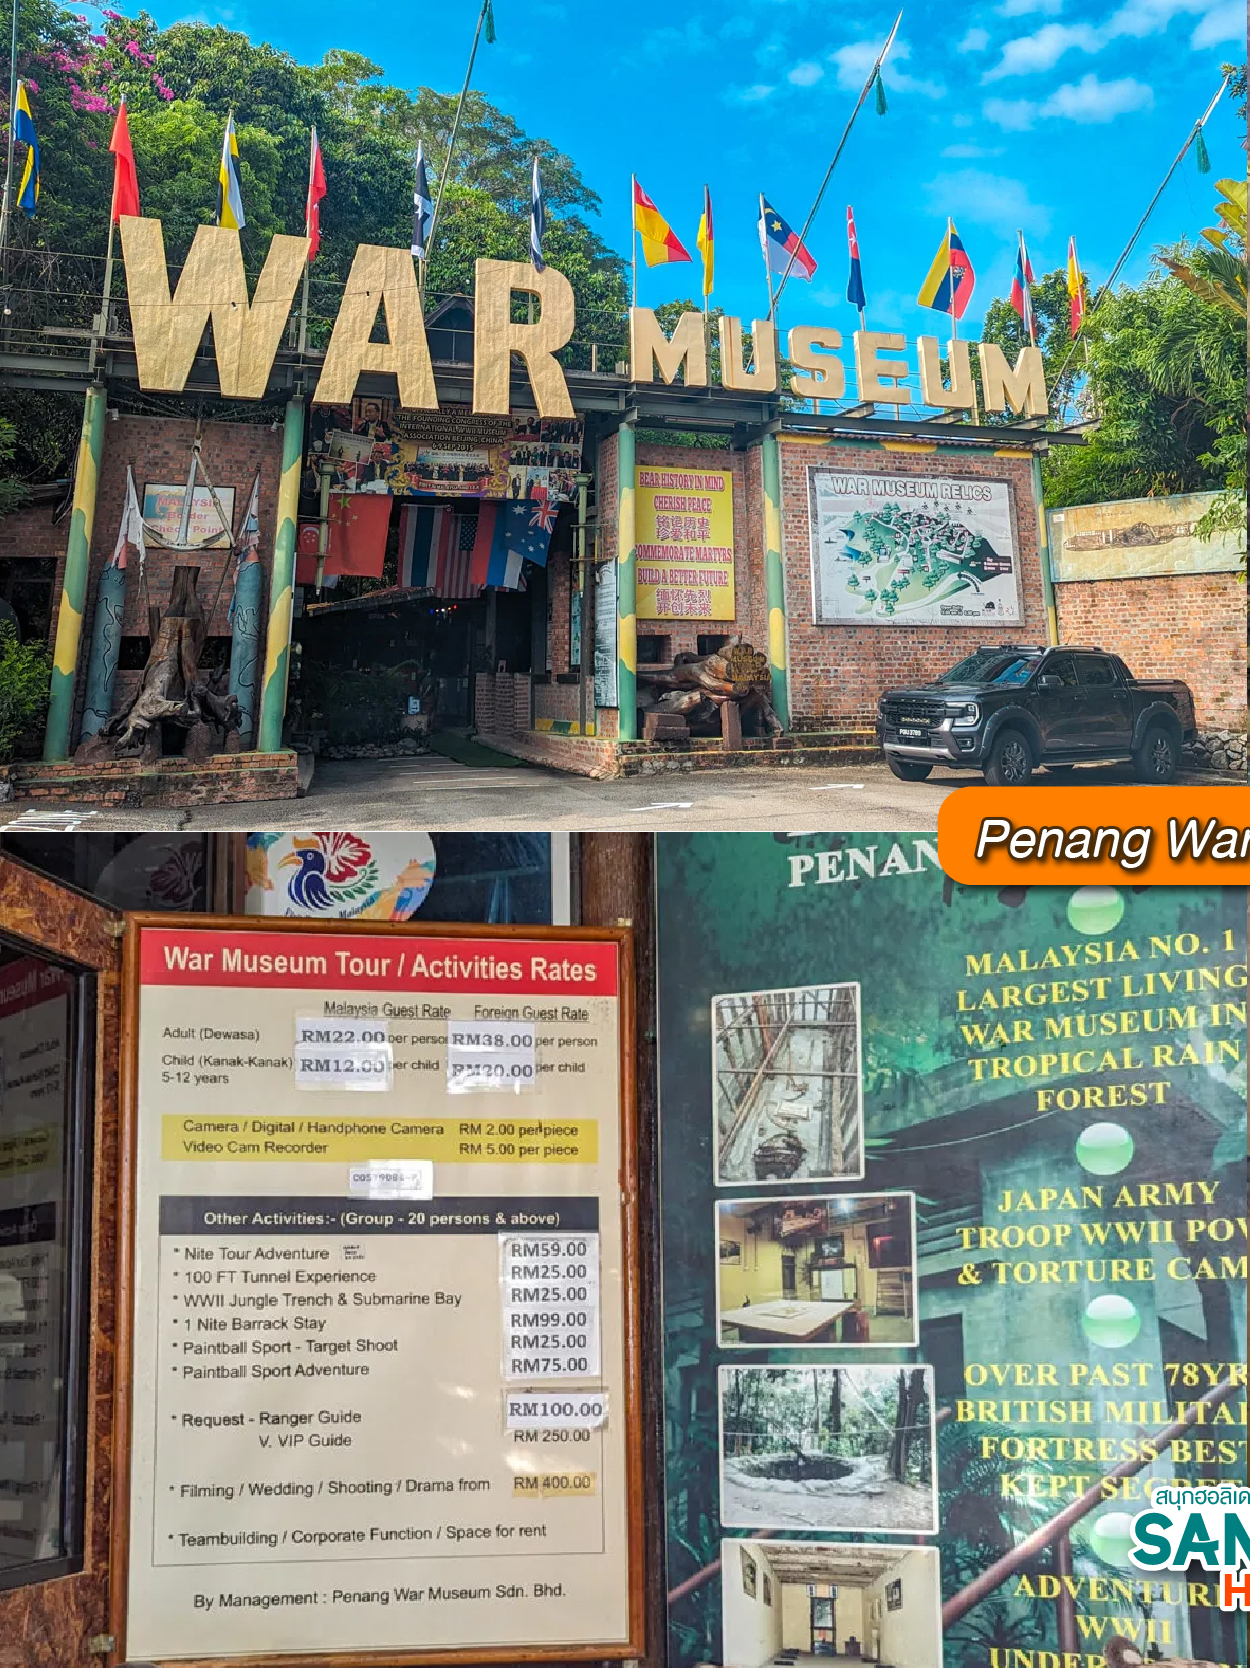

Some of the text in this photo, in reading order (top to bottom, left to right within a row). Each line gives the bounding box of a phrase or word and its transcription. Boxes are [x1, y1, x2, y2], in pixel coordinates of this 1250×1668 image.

[119, 215, 1050, 419] WAR MUSEUM
[399, 424, 456, 433] INTERNATIONAL
[477, 428, 506, 436] MUSEUM
[413, 416, 450, 424] FOUNDING
[404, 433, 450, 441] ASSOCIATION
[639, 472, 724, 491] BEAR HISTORY IN MIND
[832, 477, 992, 501] WAR MUSEUM RELICS
[167, 512, 209, 520] Boder
[654, 495, 712, 513] CHERISH PEACE
[656, 528, 711, 542] 珍爱和平
[695, 546, 732, 563] MARTYRS
[638, 568, 729, 586] BUILD A BETTER FUTURE
[164, 946, 213, 972] War
[221, 948, 327, 976] Museum
[335, 951, 390, 978] Tour
[412, 954, 521, 980] Activities
[530, 957, 597, 982] Rates
[965, 929, 1236, 977] MALAYSIA NO. 1
[956, 964, 1247, 1012] LARGEST LIVING
[324, 1001, 452, 1018] Malaysia Guest Rate
[474, 1004, 589, 1022] Foreign Guest Rate
[961, 1001, 1247, 1048] WAR MUSEUM IN
[163, 1027, 195, 1041] Adult
[199, 1028, 260, 1043] (Dewasa)
[301, 1028, 386, 1045] RM22.00
[388, 1034, 409, 1047] per
[453, 1034, 533, 1049] RM38.00
[535, 1036, 555, 1050] per
[559, 1036, 598, 1049] person
[162, 1054, 195, 1067] Child
[199, 1054, 293, 1070] (Kanak-Kanak)
[299, 1058, 385, 1074] RM12.00
[404, 1058, 440, 1071] child
[558, 1061, 586, 1074] child
[968, 1039, 1241, 1081] TROPICAL RAIN
[162, 1072, 230, 1087] 5-12 years
[1036, 1081, 1171, 1112] FOREST
[997, 1180, 1220, 1214] JAPAN ARMY
[204, 1211, 560, 1230] Other Activities:- (Group 20 persons & above)
[956, 1222, 1071, 1251] TROOP
[1083, 1219, 1175, 1247] WWII
[185, 1248, 216, 1261] Nite
[220, 1247, 251, 1261] Tour
[254, 1247, 330, 1261] Adventure
[511, 1242, 587, 1258] RM59.00
[957, 1255, 1247, 1286] & TORTURE CAM
[963, 1362, 1060, 1388] OVER
[1070, 1362, 1154, 1387] PAST
[956, 1400, 1092, 1425] BRITISH
[982, 1436, 1159, 1463] FORTRESS
[1000, 1474, 1090, 1499] KEPT
[193, 1583, 566, 1610] By Management Penang War Museum Sdn. Bhd.
[1075, 1614, 1172, 1645] WWII
